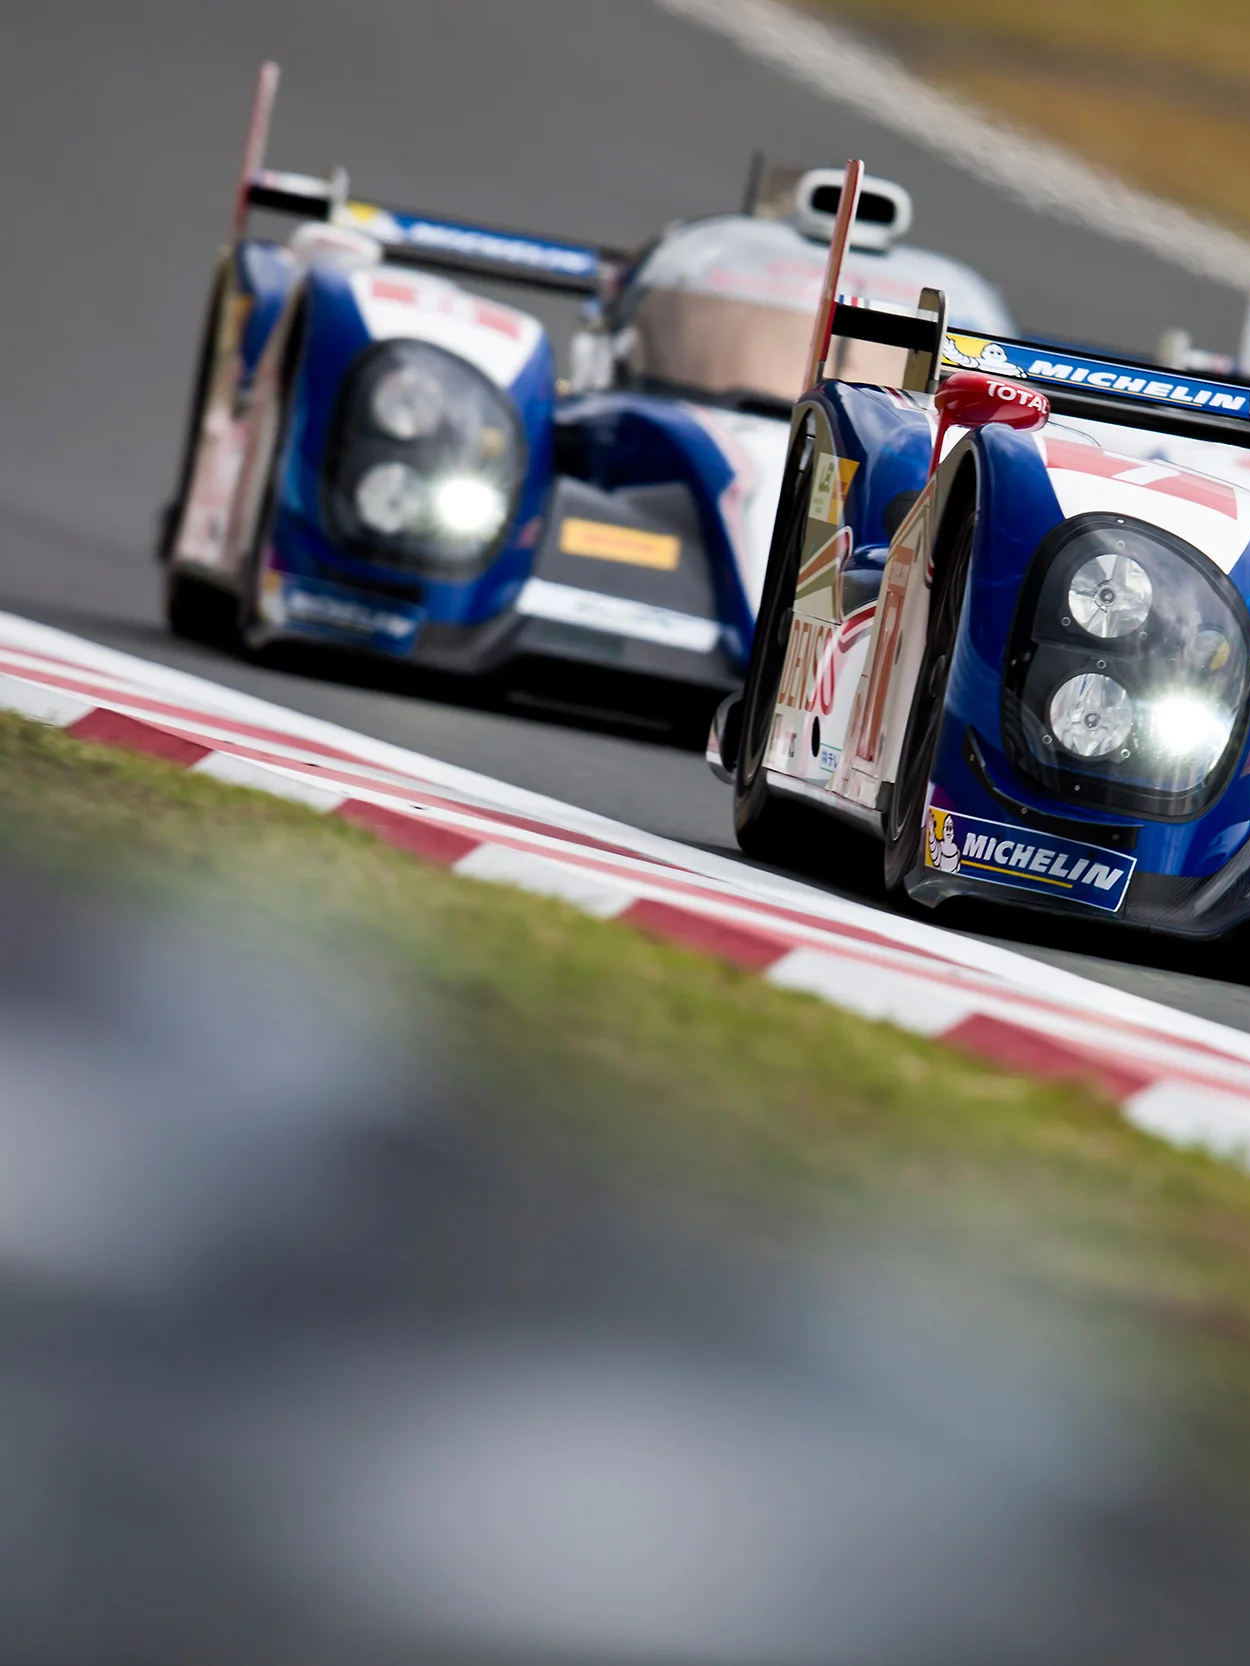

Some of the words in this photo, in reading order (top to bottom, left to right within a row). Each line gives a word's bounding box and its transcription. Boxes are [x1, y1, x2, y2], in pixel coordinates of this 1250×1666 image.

[986, 380, 1048, 415] TOTAL
[1028, 360, 1246, 411] MICHELIN
[962, 832, 1125, 891] MICHELIN
